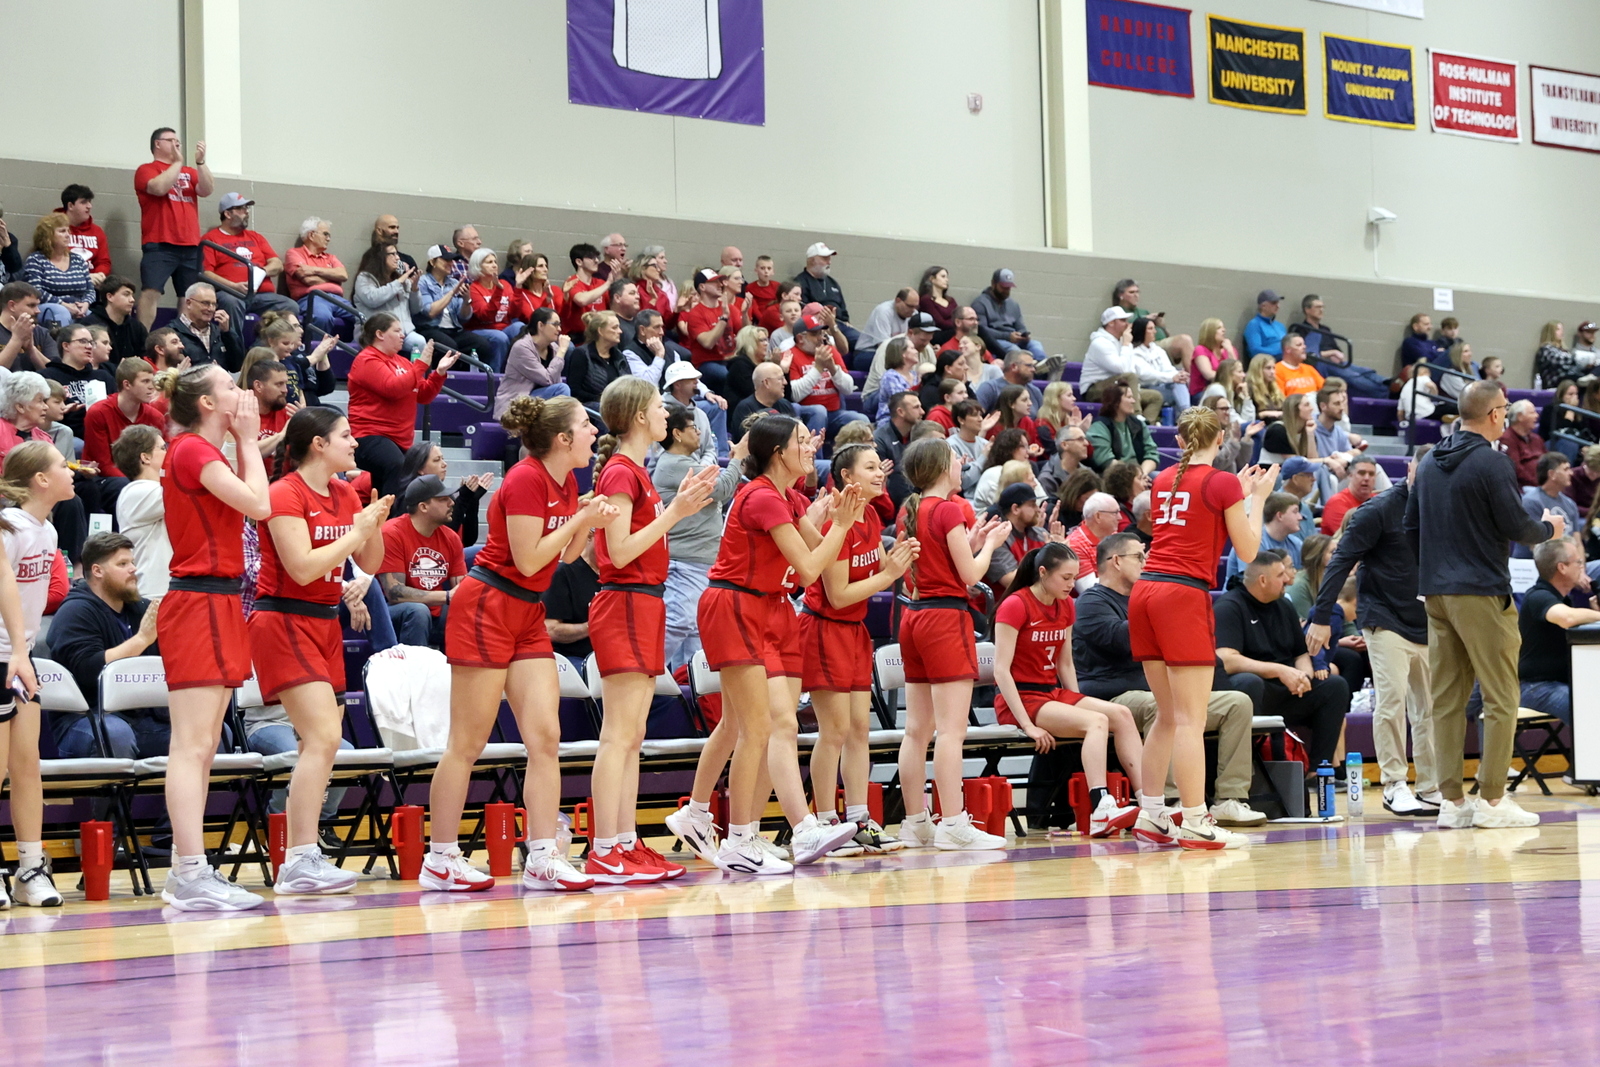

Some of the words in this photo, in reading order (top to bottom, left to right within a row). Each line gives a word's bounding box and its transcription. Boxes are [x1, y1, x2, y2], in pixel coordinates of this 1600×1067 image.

[1100, 14, 1175, 42] HANOVER
[1215, 31, 1300, 61] MANCHESTER
[1101, 49, 1177, 76] COLLEGE
[1331, 58, 1362, 76] MOUNT
[1362, 64, 1375, 78] ST.
[1376, 66, 1409, 82] JOSEPH
[1438, 61, 1511, 87] ROSE-HULMAN
[1221, 69, 1296, 97] UNIVERSITY
[1345, 82, 1395, 101] UNIVERSITY
[1449, 84, 1503, 107] INSTITUTE
[1434, 104, 1450, 120] OF
[1450, 107, 1516, 131] TECHNOLOGY
[1551, 116, 1598, 136] UNIVERSITY
[1155, 491, 1191, 527] 32
